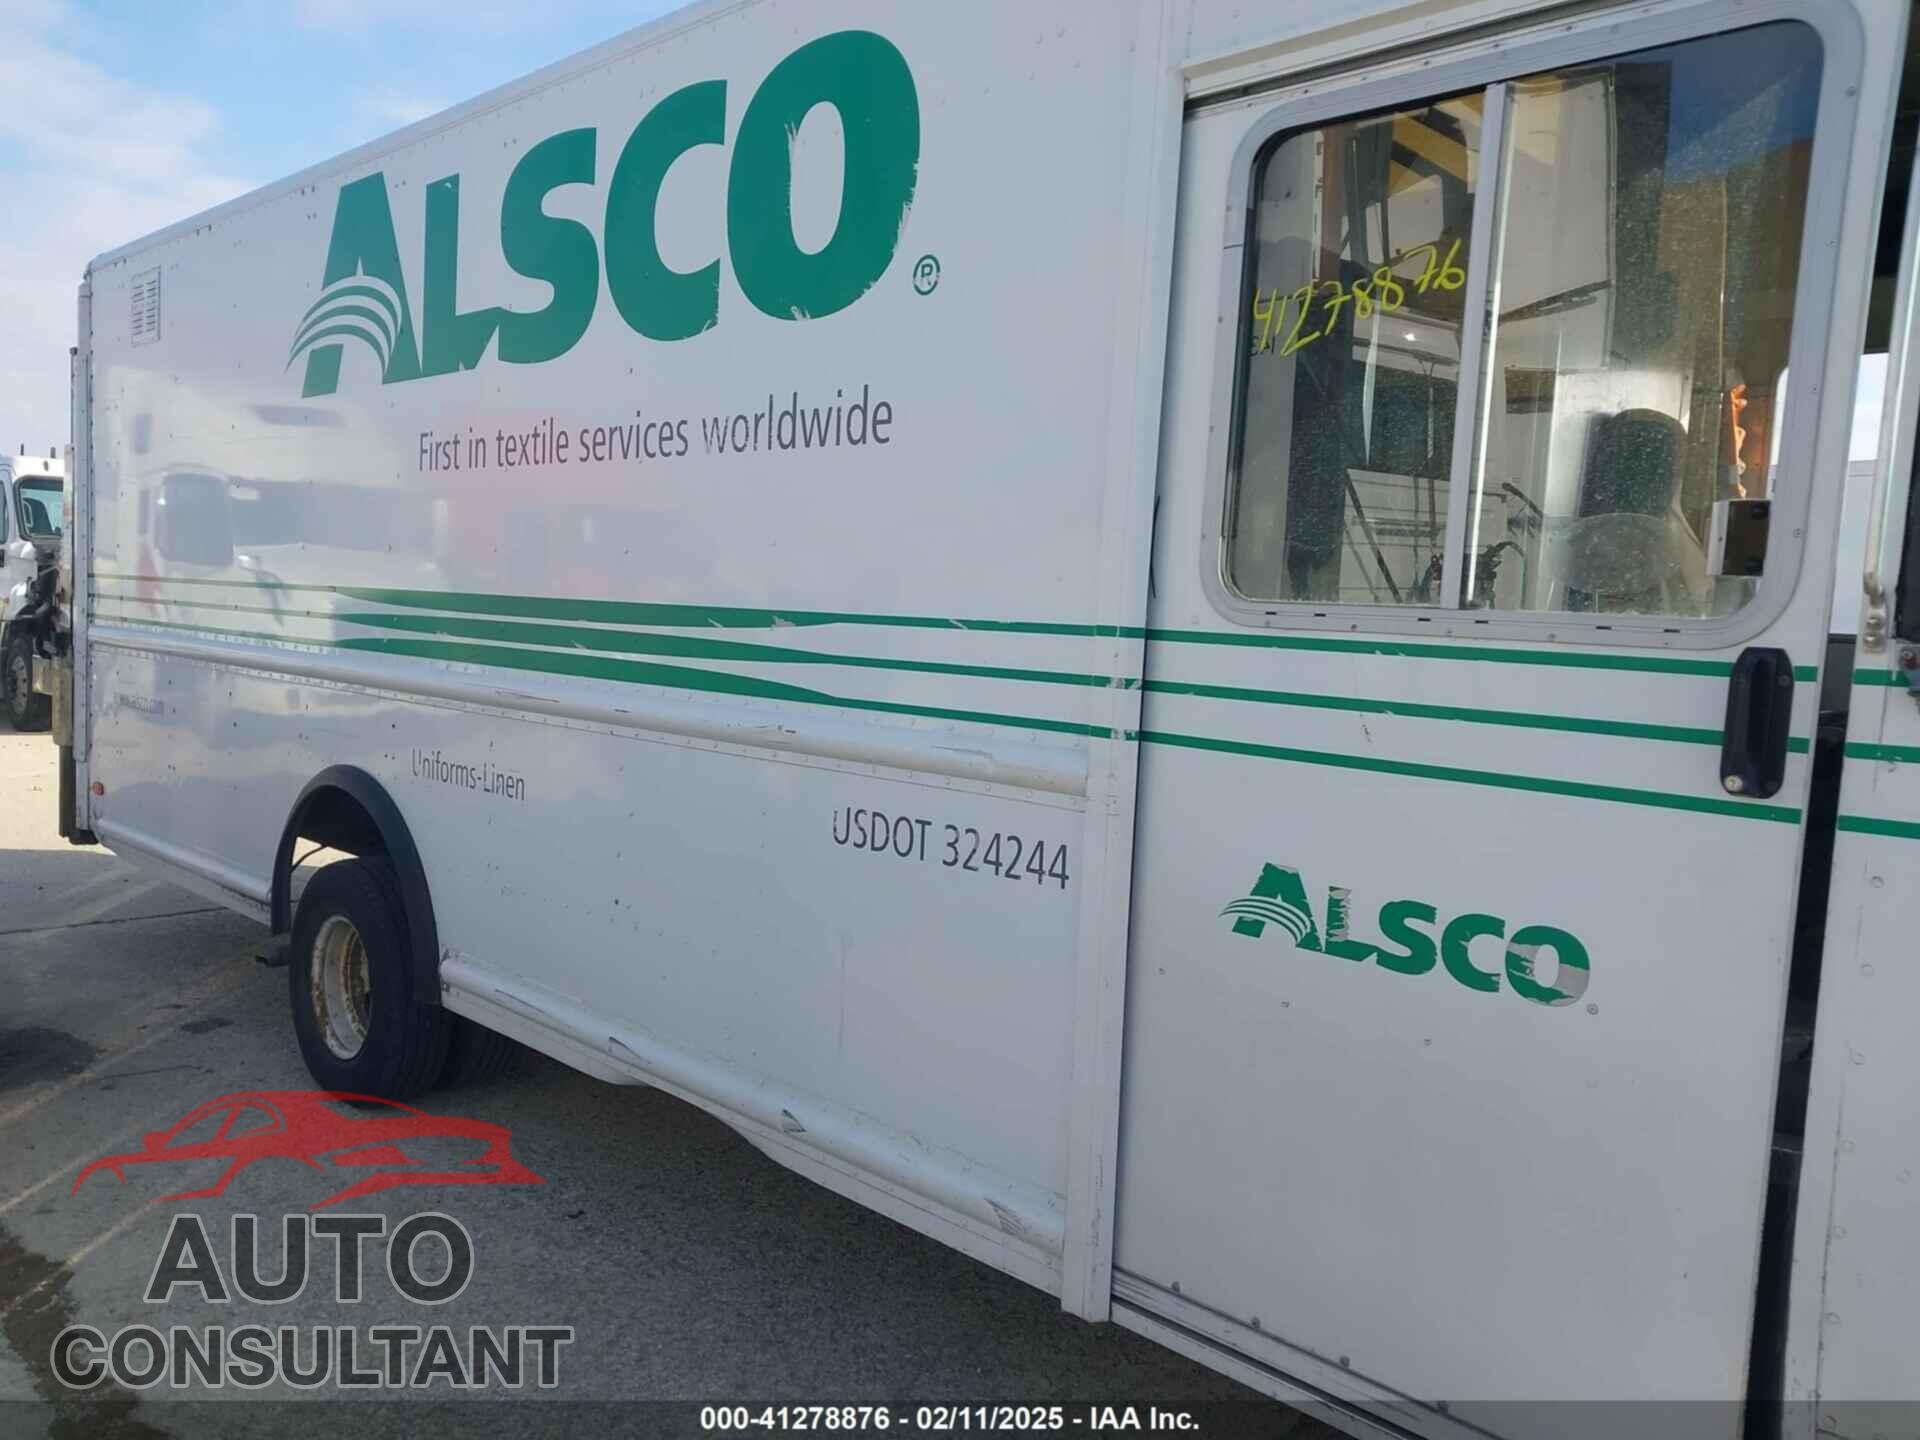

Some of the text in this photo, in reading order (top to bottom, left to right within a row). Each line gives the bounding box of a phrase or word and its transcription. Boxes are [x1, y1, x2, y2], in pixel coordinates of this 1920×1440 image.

[284, 29, 921, 399] ALSCO
[419, 384, 894, 472] First in textile services worldwide
[411, 747, 526, 801] Uniforms-Linen
[833, 806, 1070, 890] USDOT 324244
[1217, 862, 1591, 1008] ALSCO
